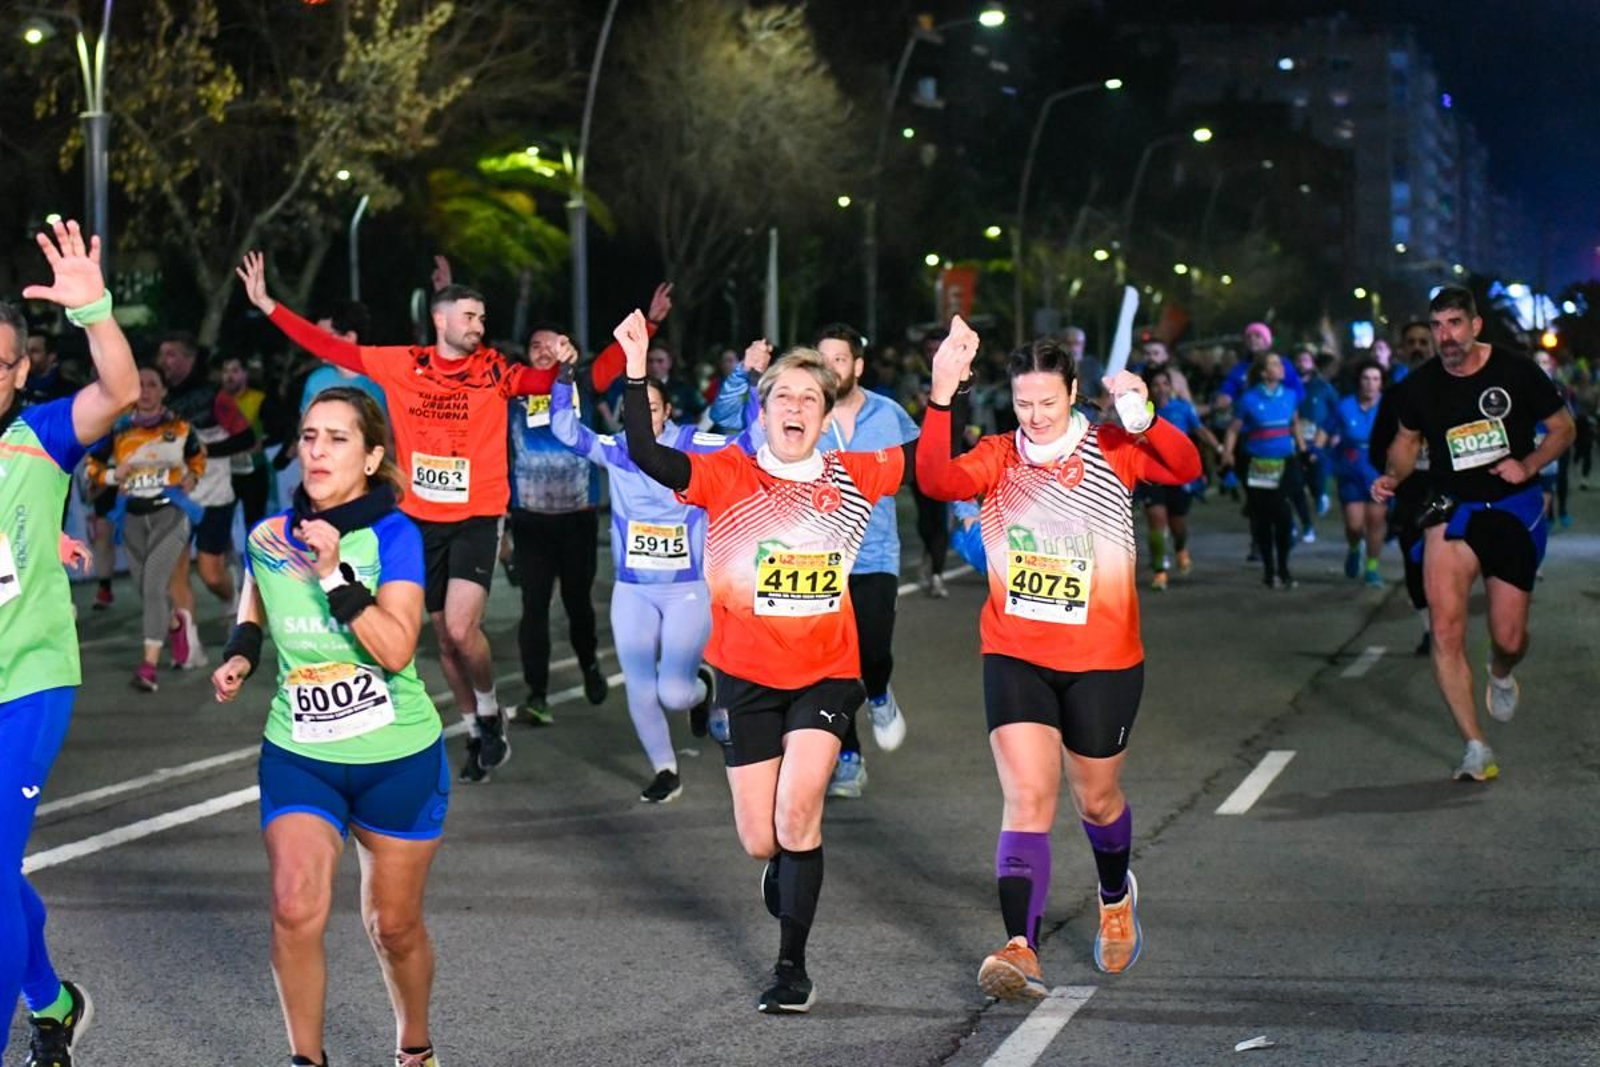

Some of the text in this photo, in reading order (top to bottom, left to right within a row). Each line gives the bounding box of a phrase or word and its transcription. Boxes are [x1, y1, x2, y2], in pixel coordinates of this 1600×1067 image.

[408, 406, 469, 421] NOCTURNA
[422, 400, 469, 411] URBANA
[1452, 430, 1503, 454] 3022
[416, 466, 463, 486] 6063
[633, 534, 684, 553] 5915
[763, 568, 837, 593] 4112
[1011, 569, 1081, 600] 4075
[296, 672, 377, 713] 6002
